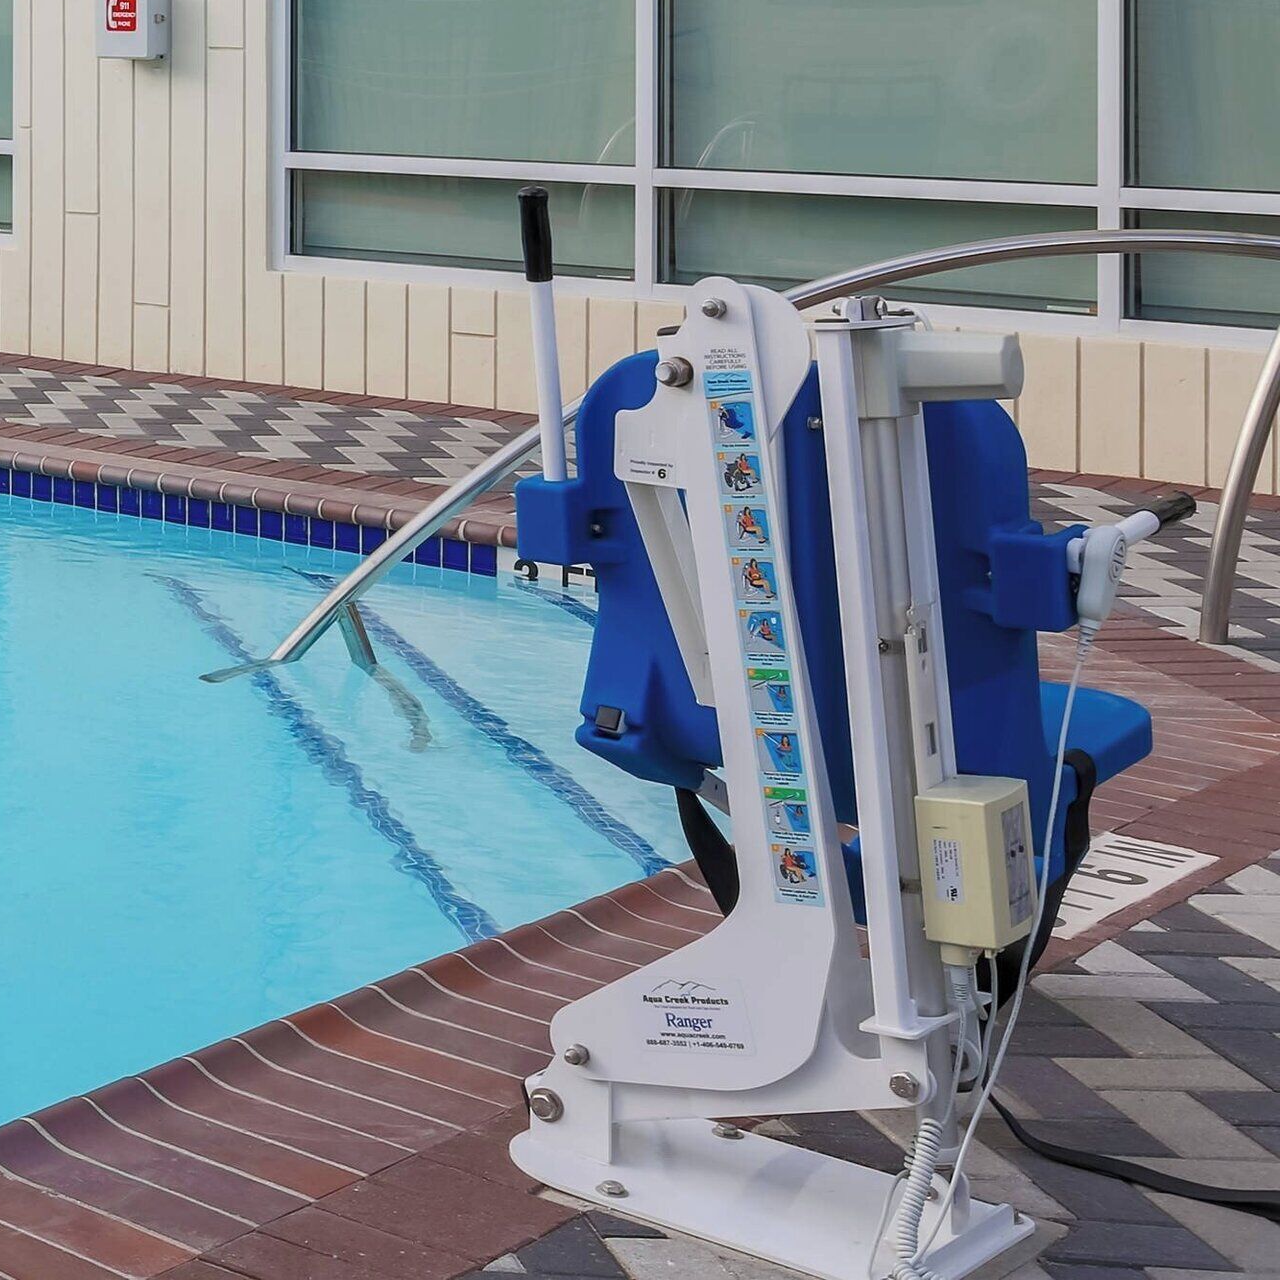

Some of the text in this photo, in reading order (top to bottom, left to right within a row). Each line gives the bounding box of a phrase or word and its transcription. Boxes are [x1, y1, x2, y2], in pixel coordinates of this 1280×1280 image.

[119, 1, 130, 10] 911
[657, 468, 667, 479] 6
[643, 995, 729, 1005] Aqua Creek Products
[665, 1013, 713, 1031] Ranger
